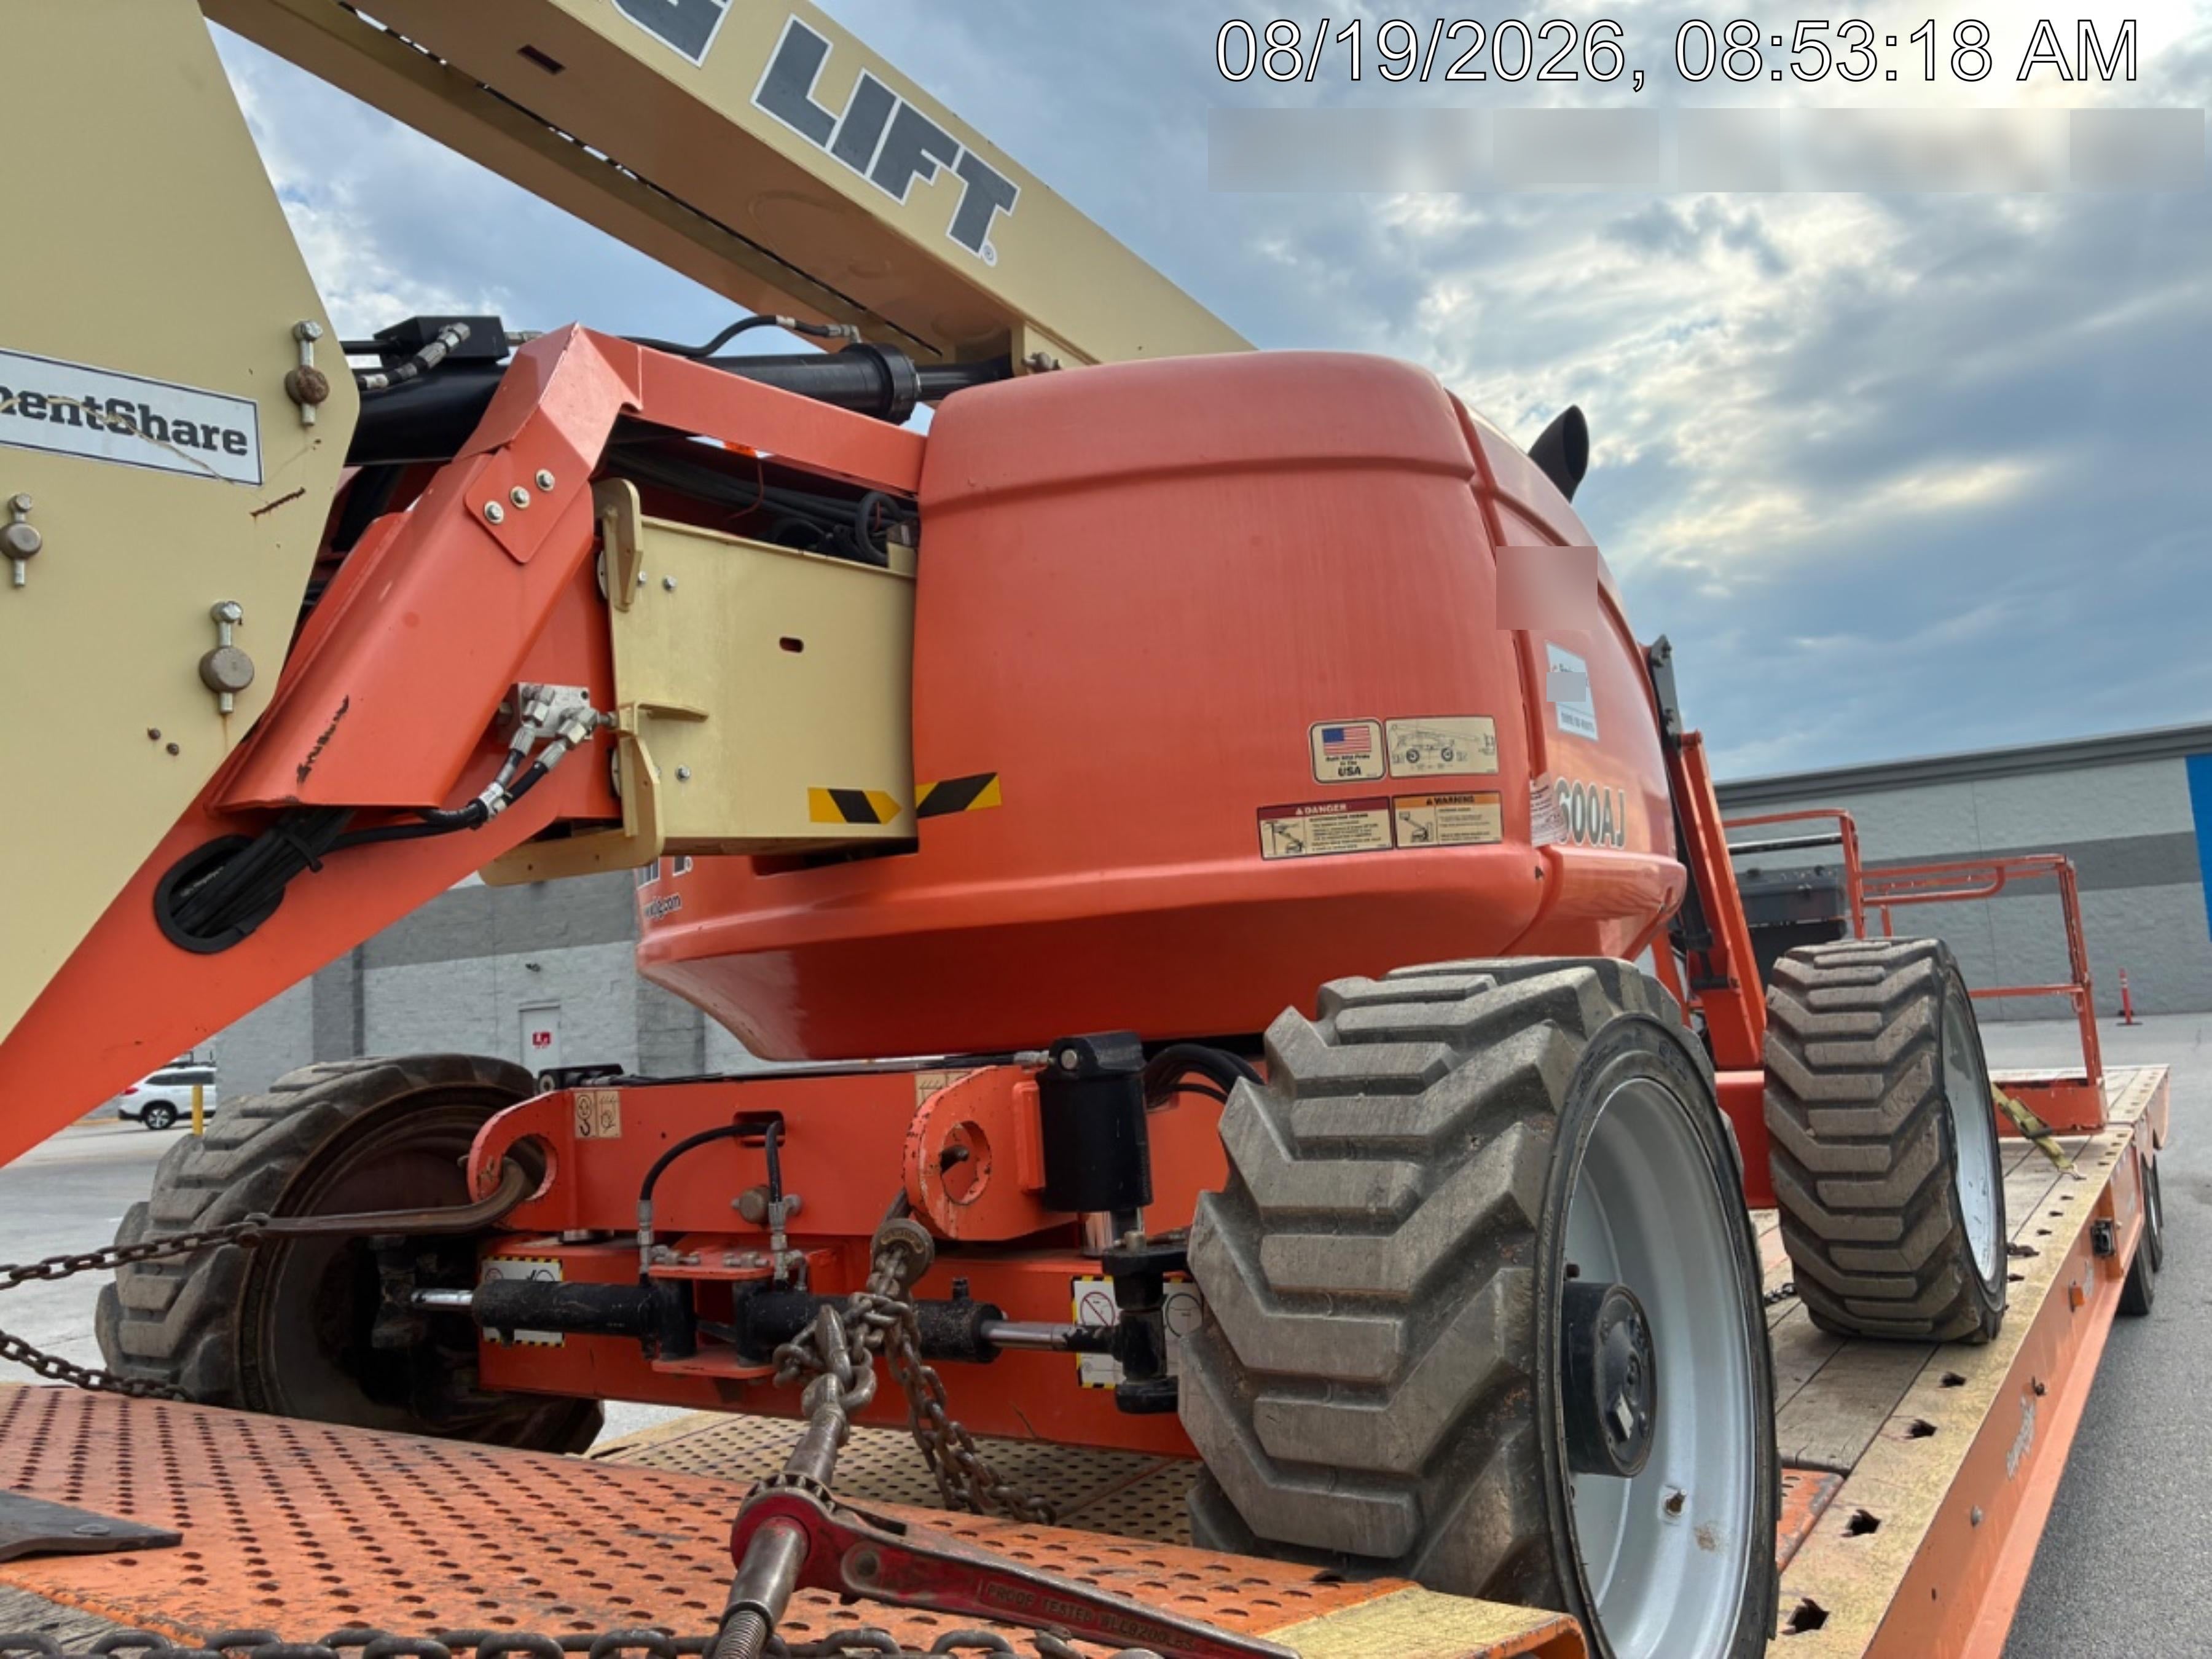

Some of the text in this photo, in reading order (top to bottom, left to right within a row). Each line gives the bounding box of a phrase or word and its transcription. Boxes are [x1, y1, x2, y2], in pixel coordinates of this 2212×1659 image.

[1338, 766, 1362, 777] USA
[1435, 795, 1475, 805] WARNING
[1304, 804, 1347, 815] DANGER
[987, 1583, 1036, 1607] PROOF
[1043, 1598, 1094, 1623] TESTED
